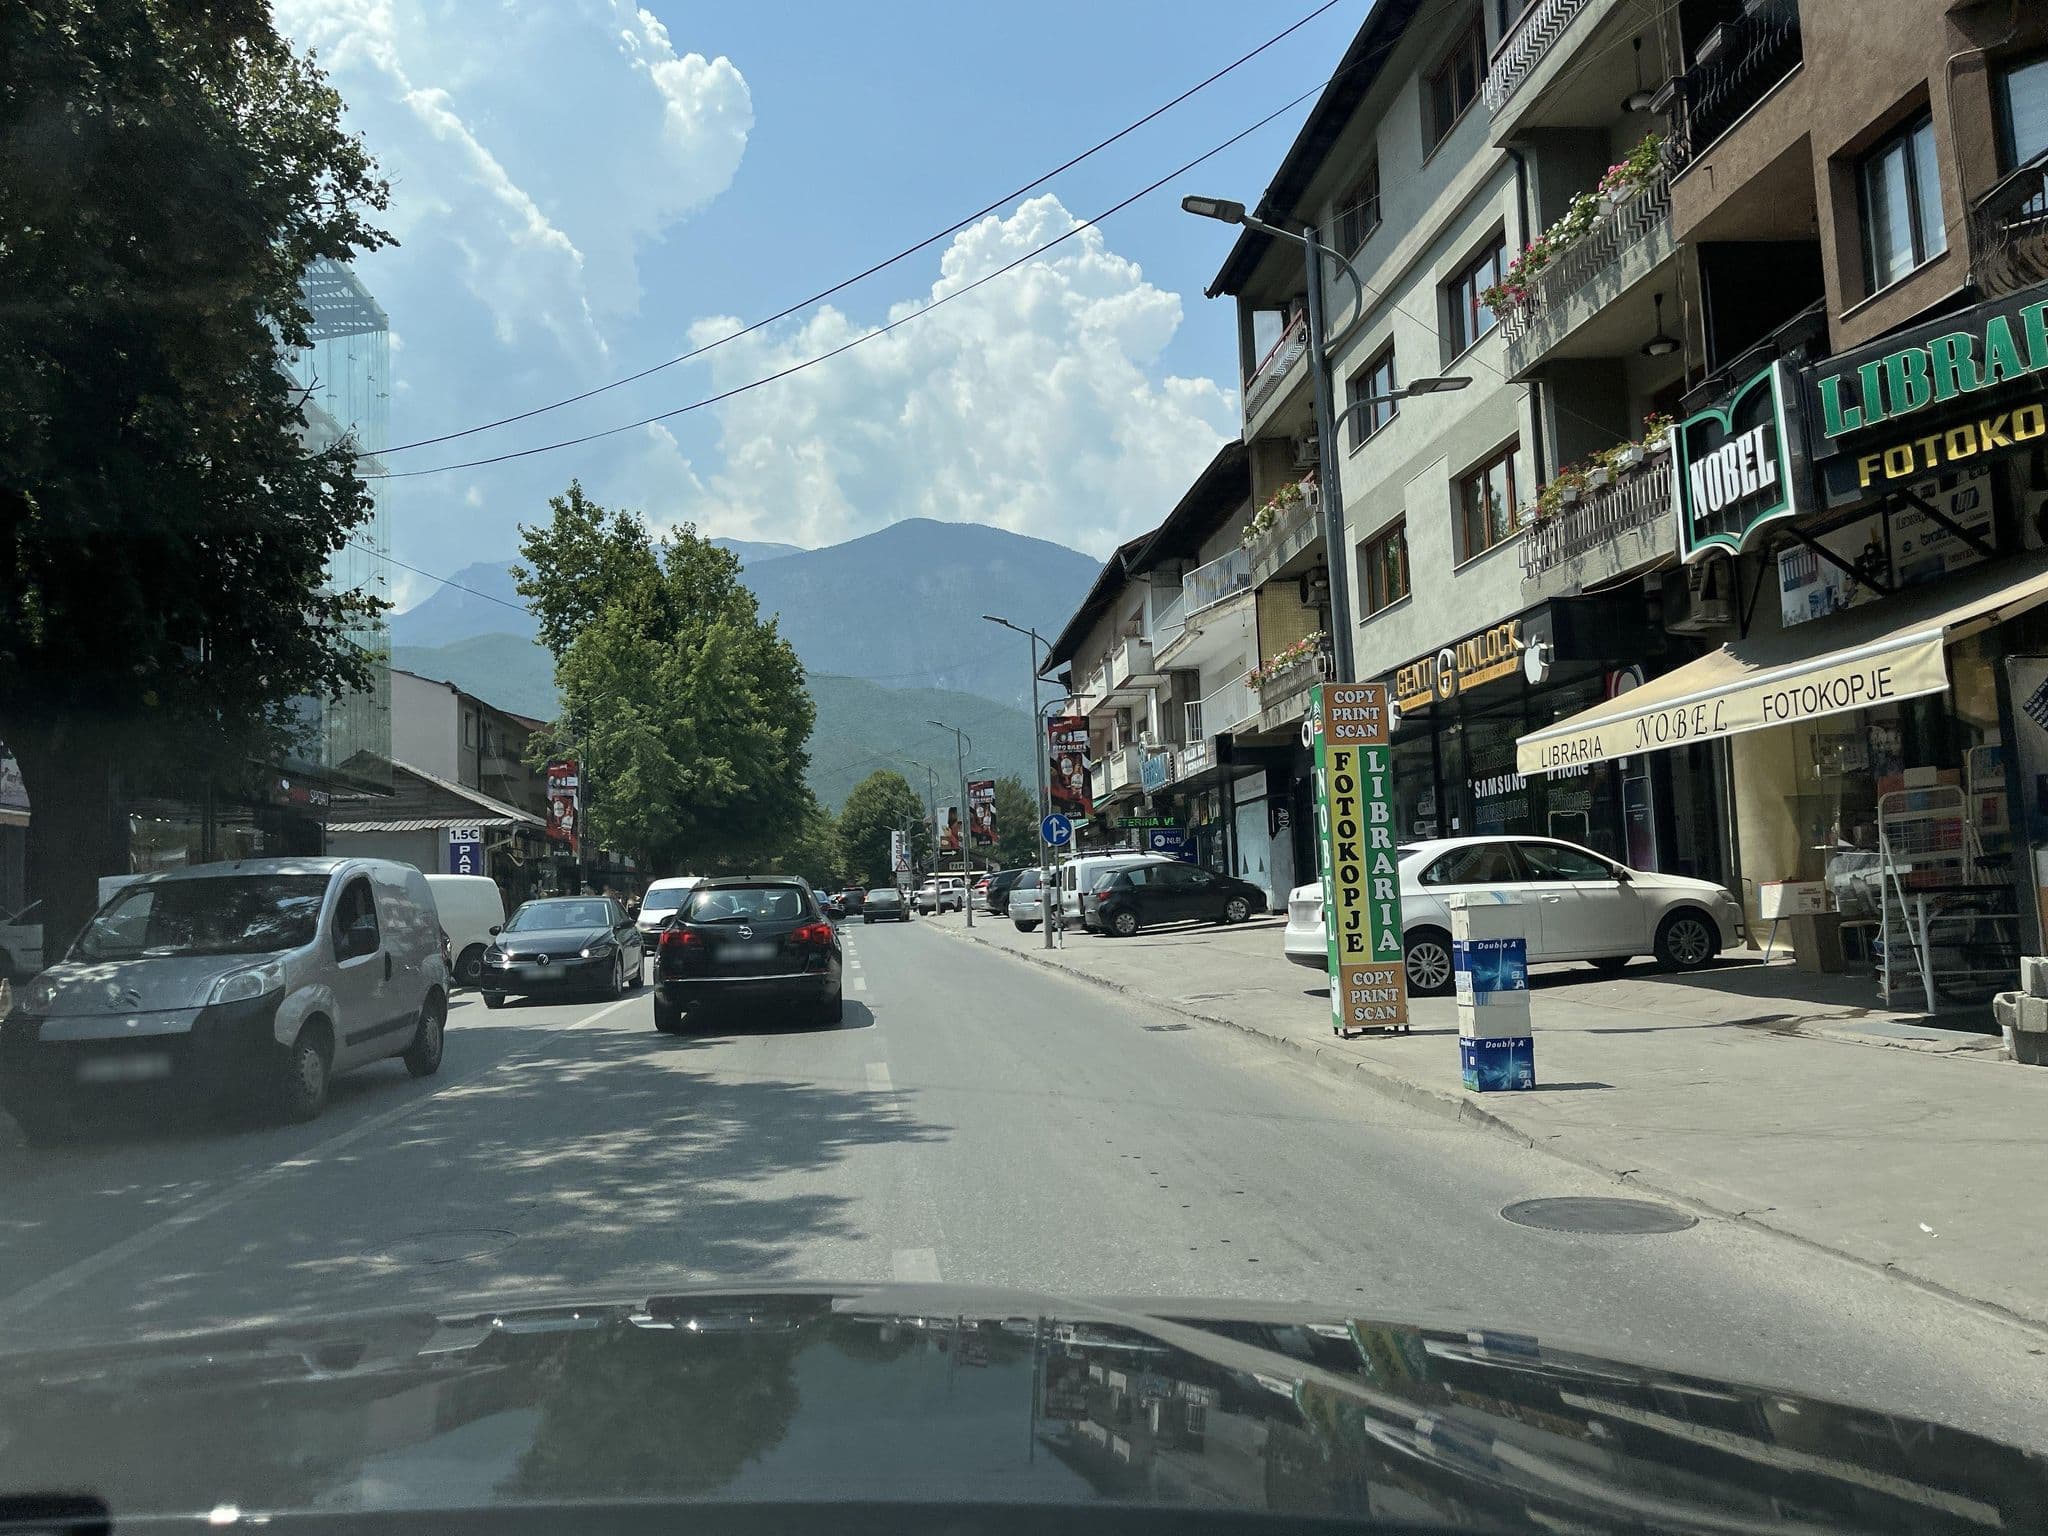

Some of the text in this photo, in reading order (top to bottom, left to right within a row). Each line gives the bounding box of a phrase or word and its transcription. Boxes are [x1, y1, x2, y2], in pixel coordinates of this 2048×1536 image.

[1857, 403, 2046, 488] FOTOKO
[1690, 424, 1776, 520] NOBEL
[1396, 657, 1435, 696] GENTI
[1456, 620, 1525, 672] UNLOCK
[1334, 690, 1376, 704] COPY
[1332, 707, 1380, 721] PRINT
[1541, 735, 1604, 768] LIBRARIA
[1635, 700, 1728, 749] NOBEL
[1763, 666, 1894, 722] FOTOKOPJE
[1335, 724, 1379, 738] SCAN
[1474, 772, 1527, 799] SAMSUNG
[1318, 768, 1335, 940] NOBEL
[1334, 752, 1364, 953] FOTOKOPJE
[1366, 751, 1401, 951] LIBRARIA
[1477, 941, 1508, 950] Double
[1352, 971, 1395, 985] COPY
[1350, 988, 1399, 1004] PRINT
[1354, 1006, 1397, 1021] SCAN
[1485, 1041, 1516, 1049] Double
